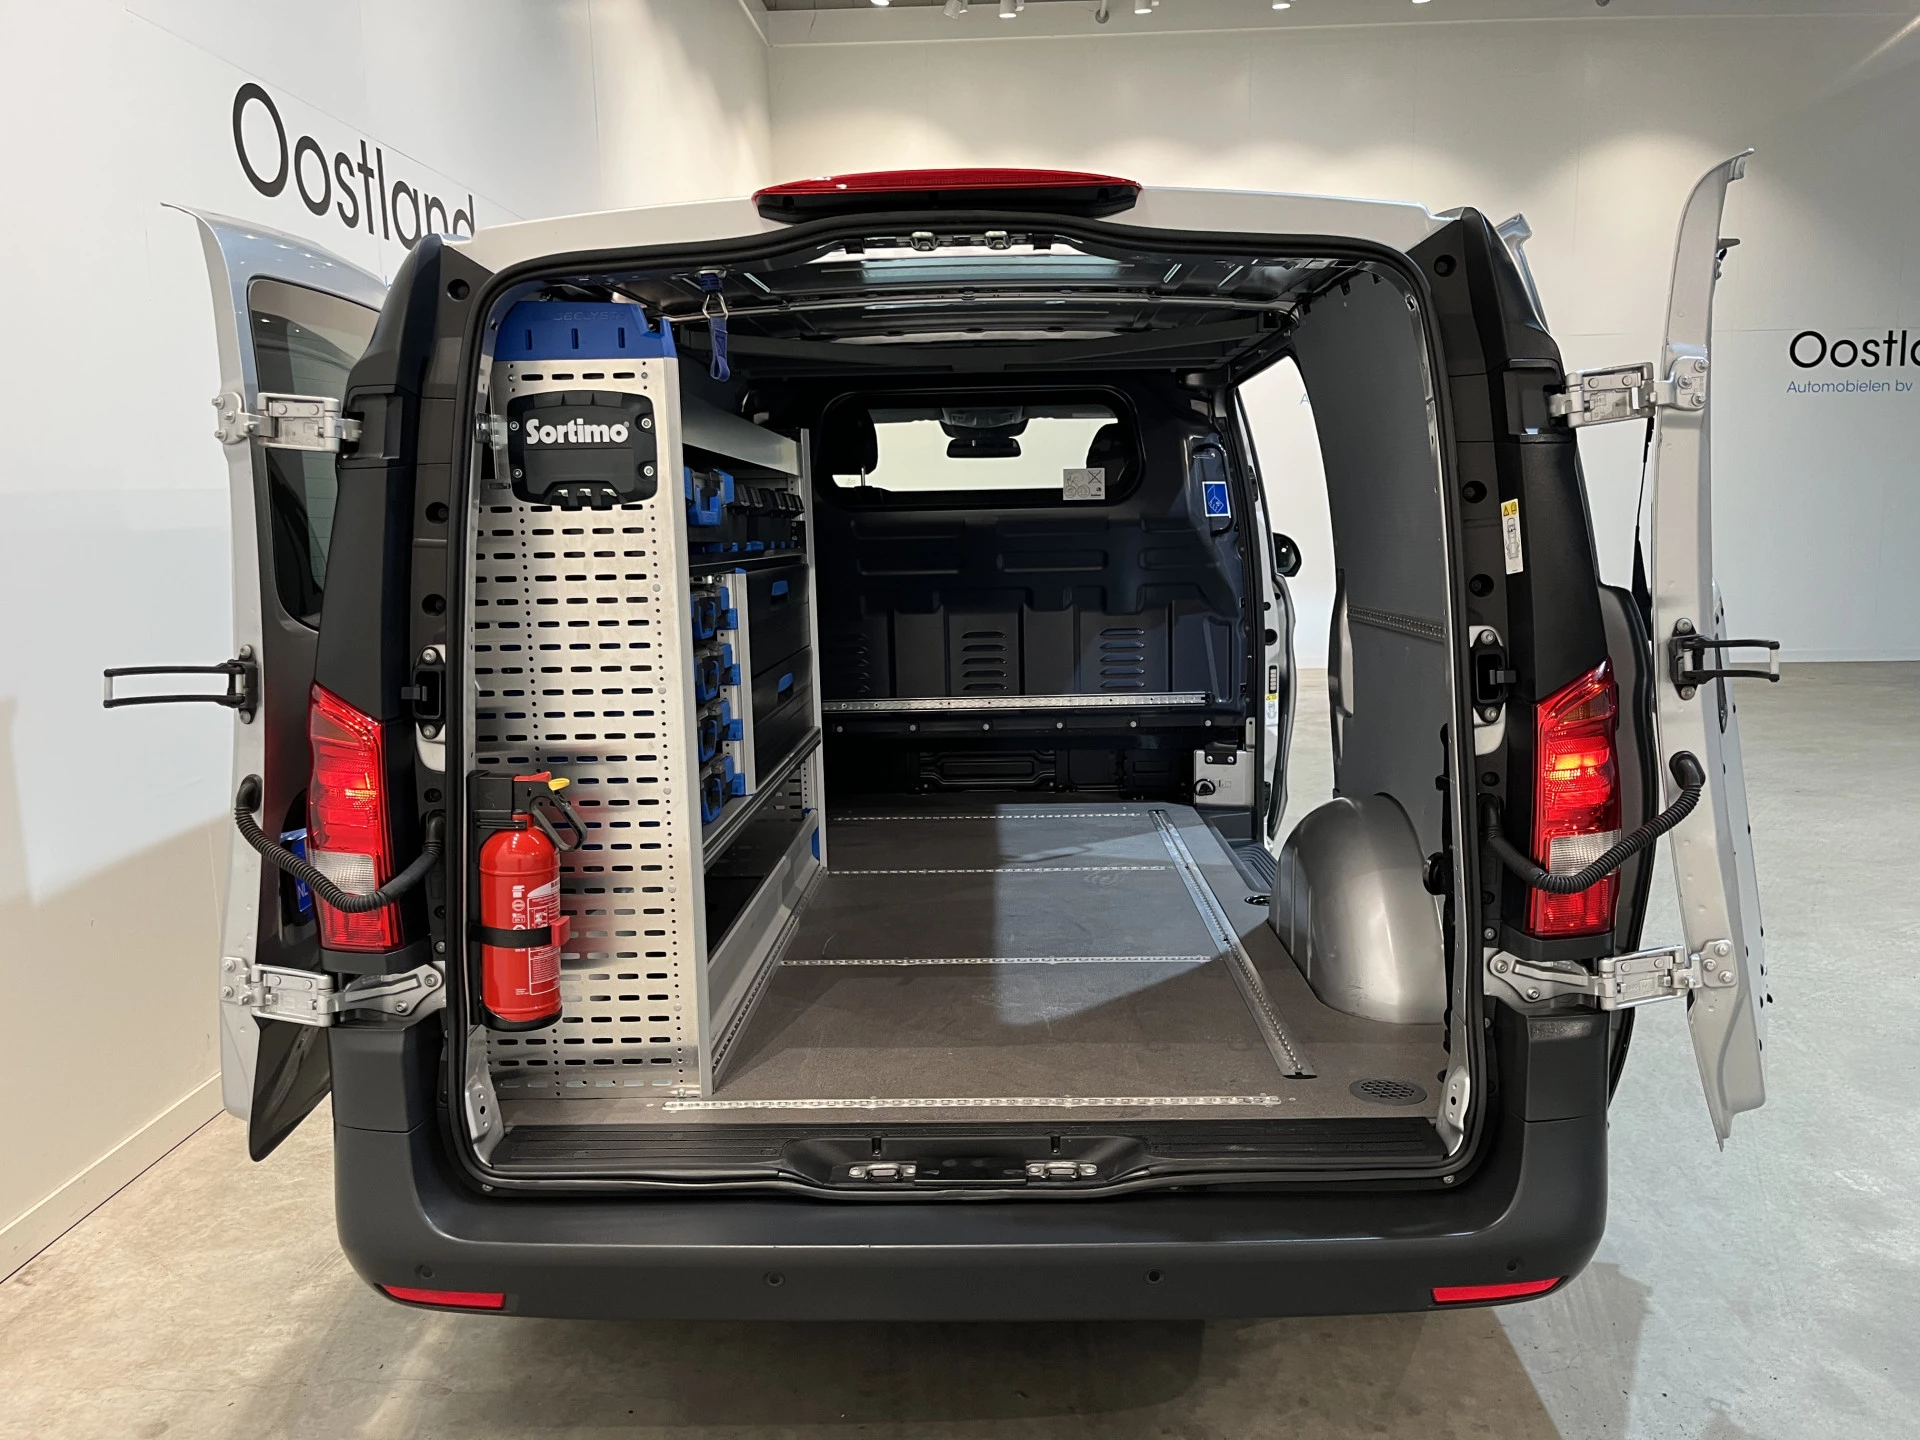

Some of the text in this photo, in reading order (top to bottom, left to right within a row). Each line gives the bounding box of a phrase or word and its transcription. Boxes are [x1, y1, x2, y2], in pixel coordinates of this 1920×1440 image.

[232, 82, 475, 251] Oostland
[1786, 379, 1913, 394] Automobielen bv
[525, 418, 629, 445] Sortimo
